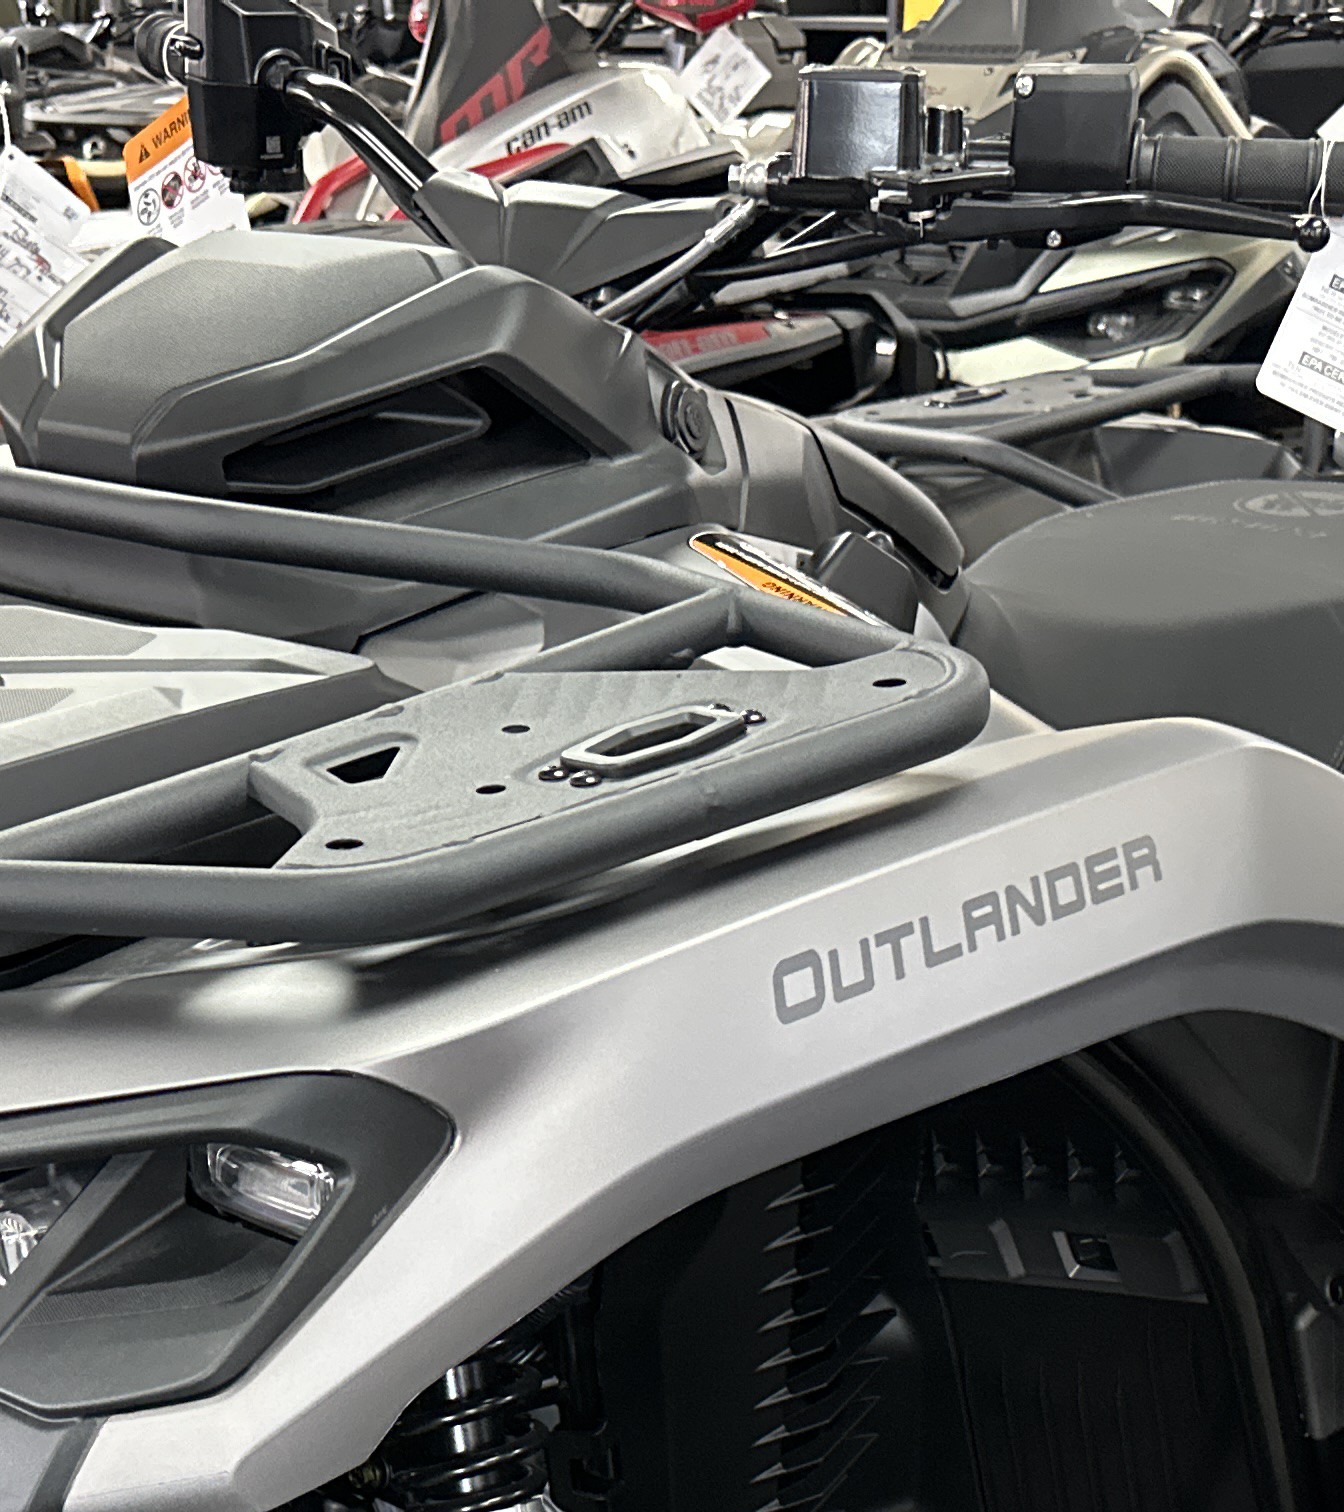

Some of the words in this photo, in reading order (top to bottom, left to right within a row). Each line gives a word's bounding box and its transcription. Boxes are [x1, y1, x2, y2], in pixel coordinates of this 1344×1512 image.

[151, 109, 191, 149] WARNI
[505, 100, 594, 155] can-am
[1301, 354, 1323, 371] EPA
[772, 834, 1163, 1025] OUTLANDER
